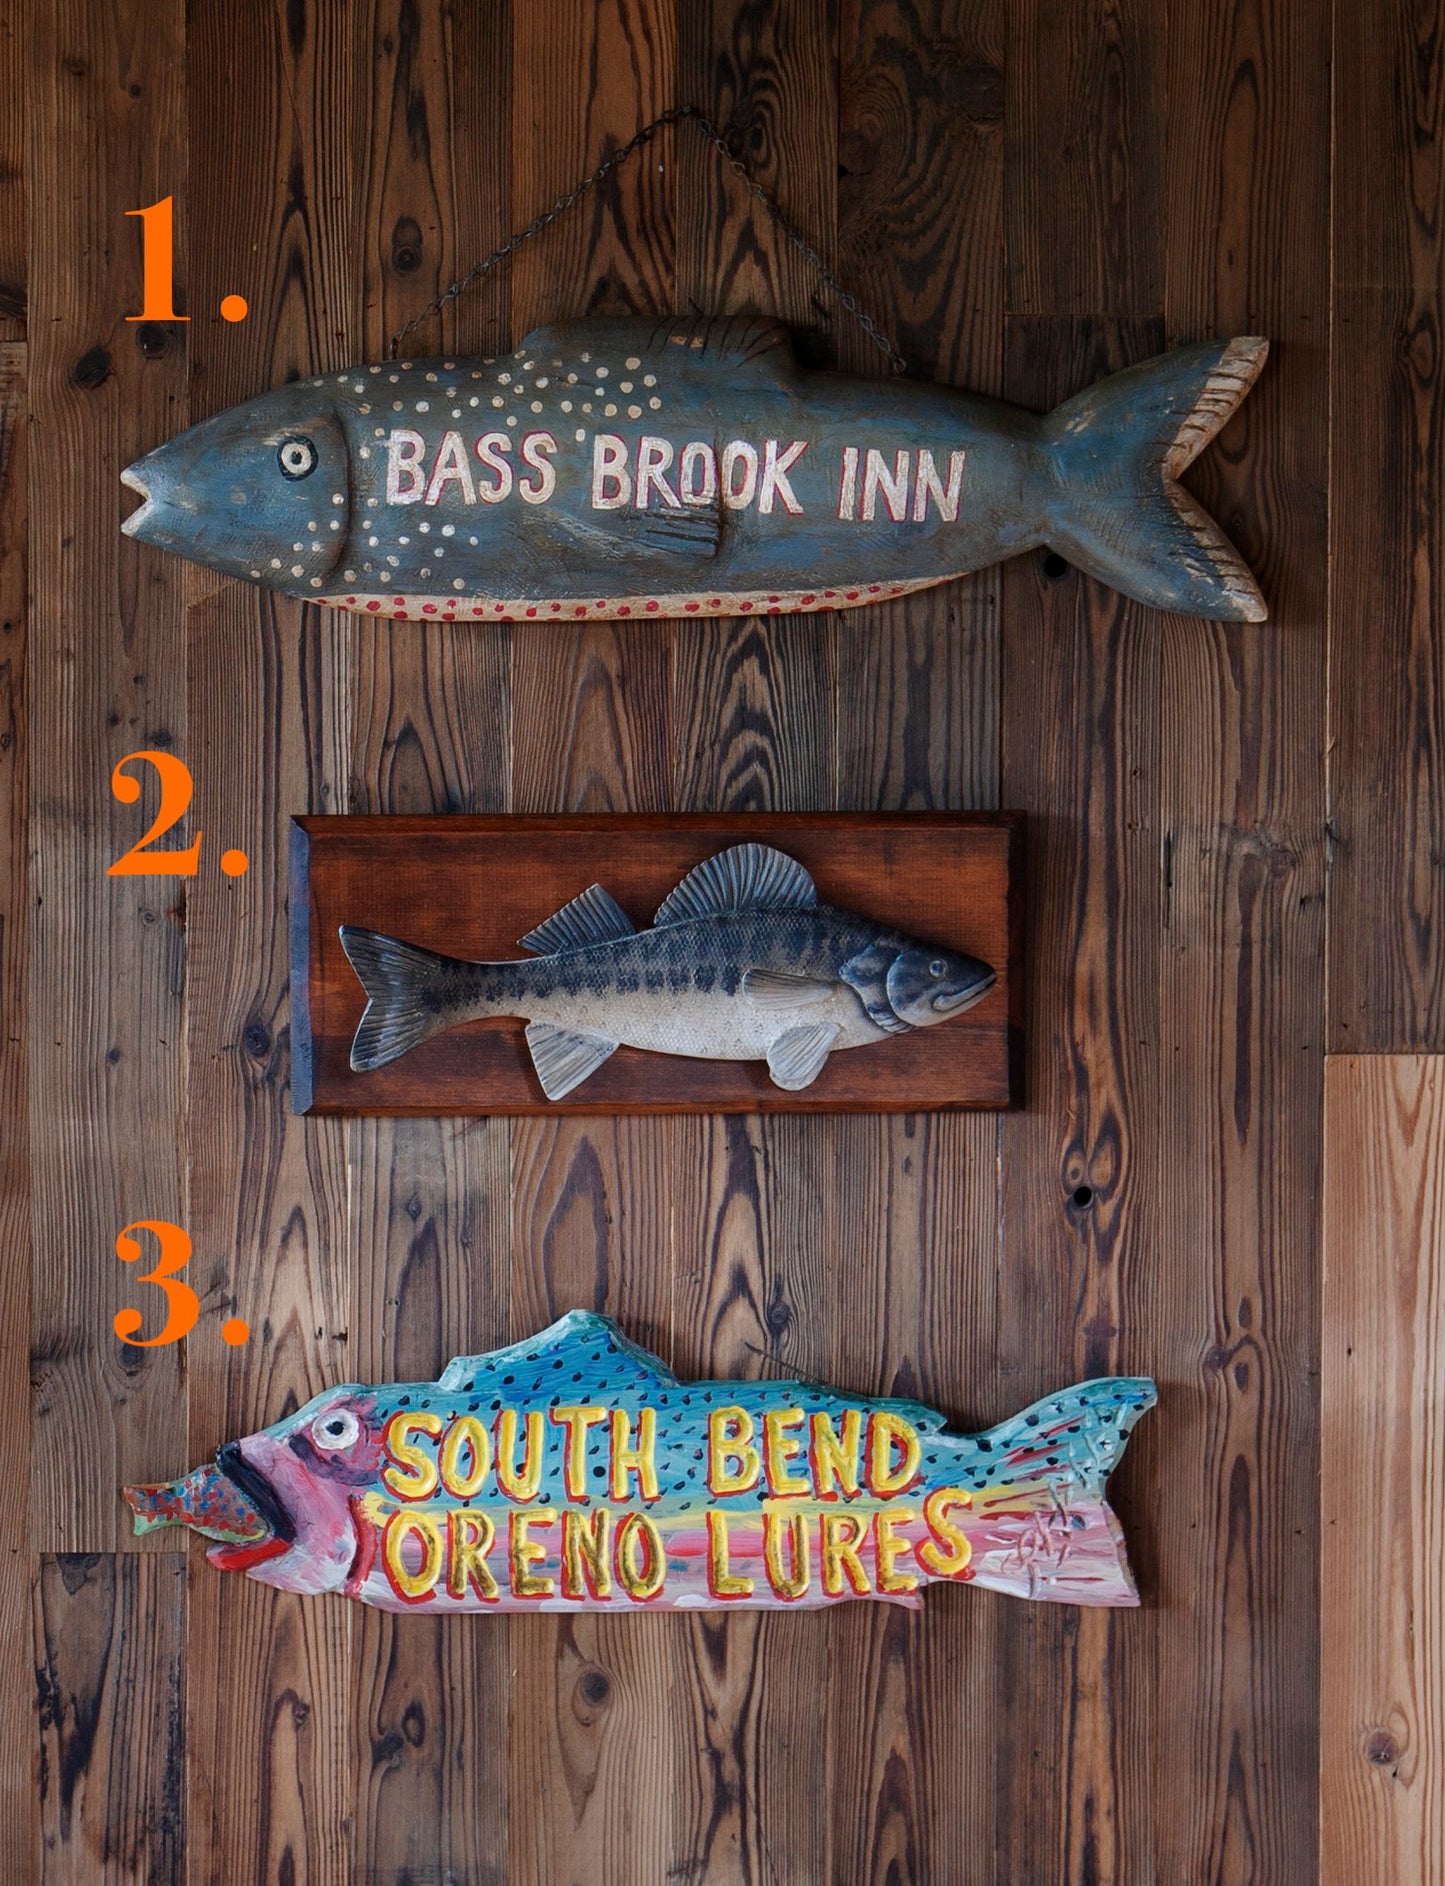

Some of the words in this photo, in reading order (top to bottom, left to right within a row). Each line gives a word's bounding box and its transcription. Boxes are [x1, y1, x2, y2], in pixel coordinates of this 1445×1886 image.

[385, 428, 557, 506] BASS
[590, 433, 809, 515] BROOK
[837, 445, 967, 523] INN
[380, 1406, 660, 1502] SOUTH
[706, 1405, 924, 1500] BEND
[380, 1507, 667, 1601] ORENO
[706, 1486, 977, 1601] LURES
